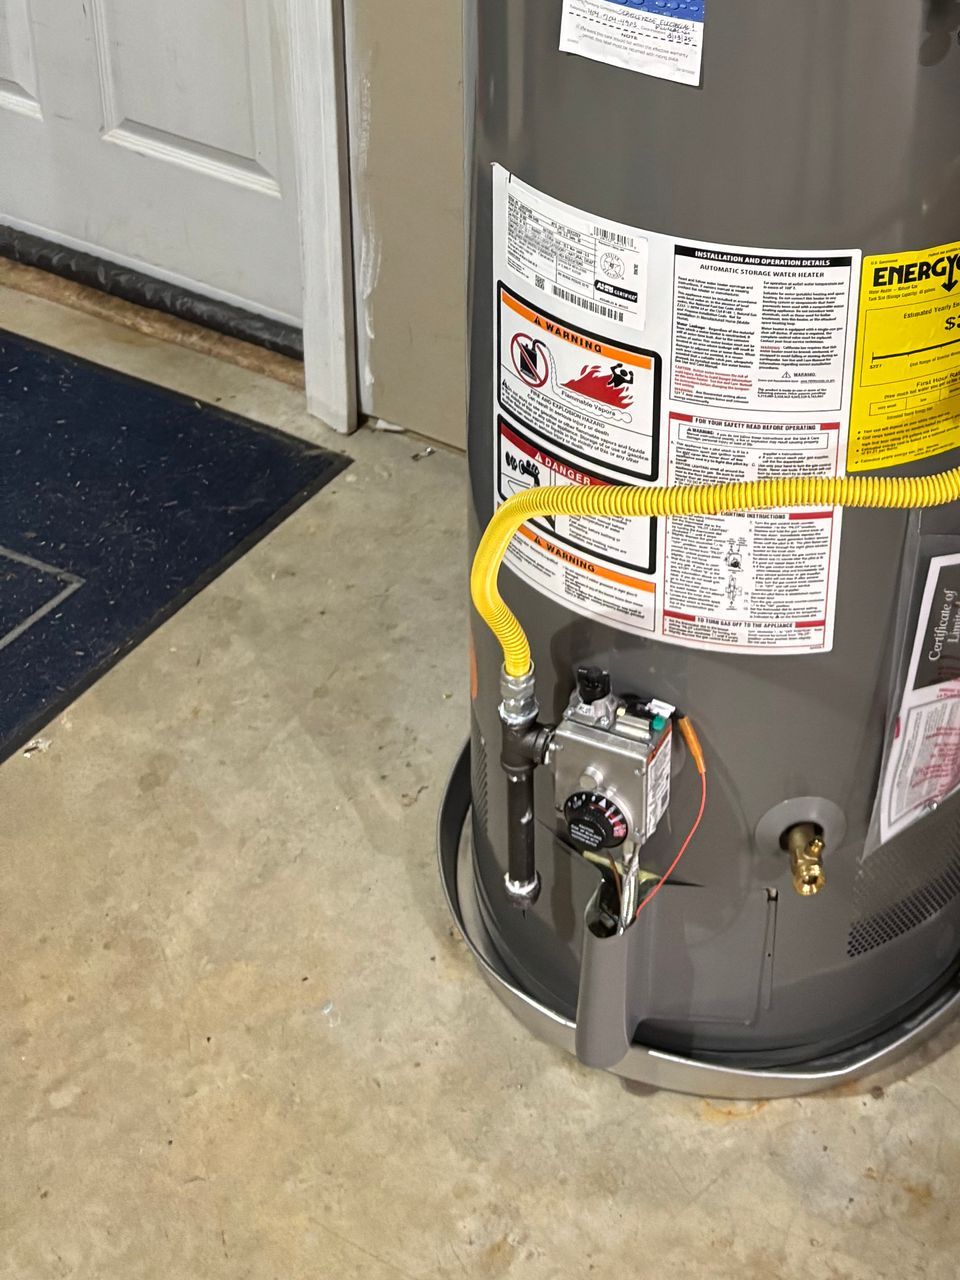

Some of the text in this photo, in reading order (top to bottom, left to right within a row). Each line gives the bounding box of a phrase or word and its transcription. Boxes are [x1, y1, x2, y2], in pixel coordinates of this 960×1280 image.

[695, 251, 743, 263] INSTALLATION
[761, 258, 800, 266] OPERATION
[700, 264, 739, 274] AUTOMATIC
[740, 269, 771, 277] STORAGE
[903, 309, 932, 319] Estimated
[934, 304, 952, 313] Yearly
[546, 322, 602, 353] WARNING
[932, 376, 948, 385] Hour
[552, 400, 581, 420] EXPLOSION
[561, 390, 616, 416] Flammable Vapors
[545, 458, 590, 486] DANGER
[546, 543, 595, 573] WARNING
[928, 588, 958, 661] Certificate of
